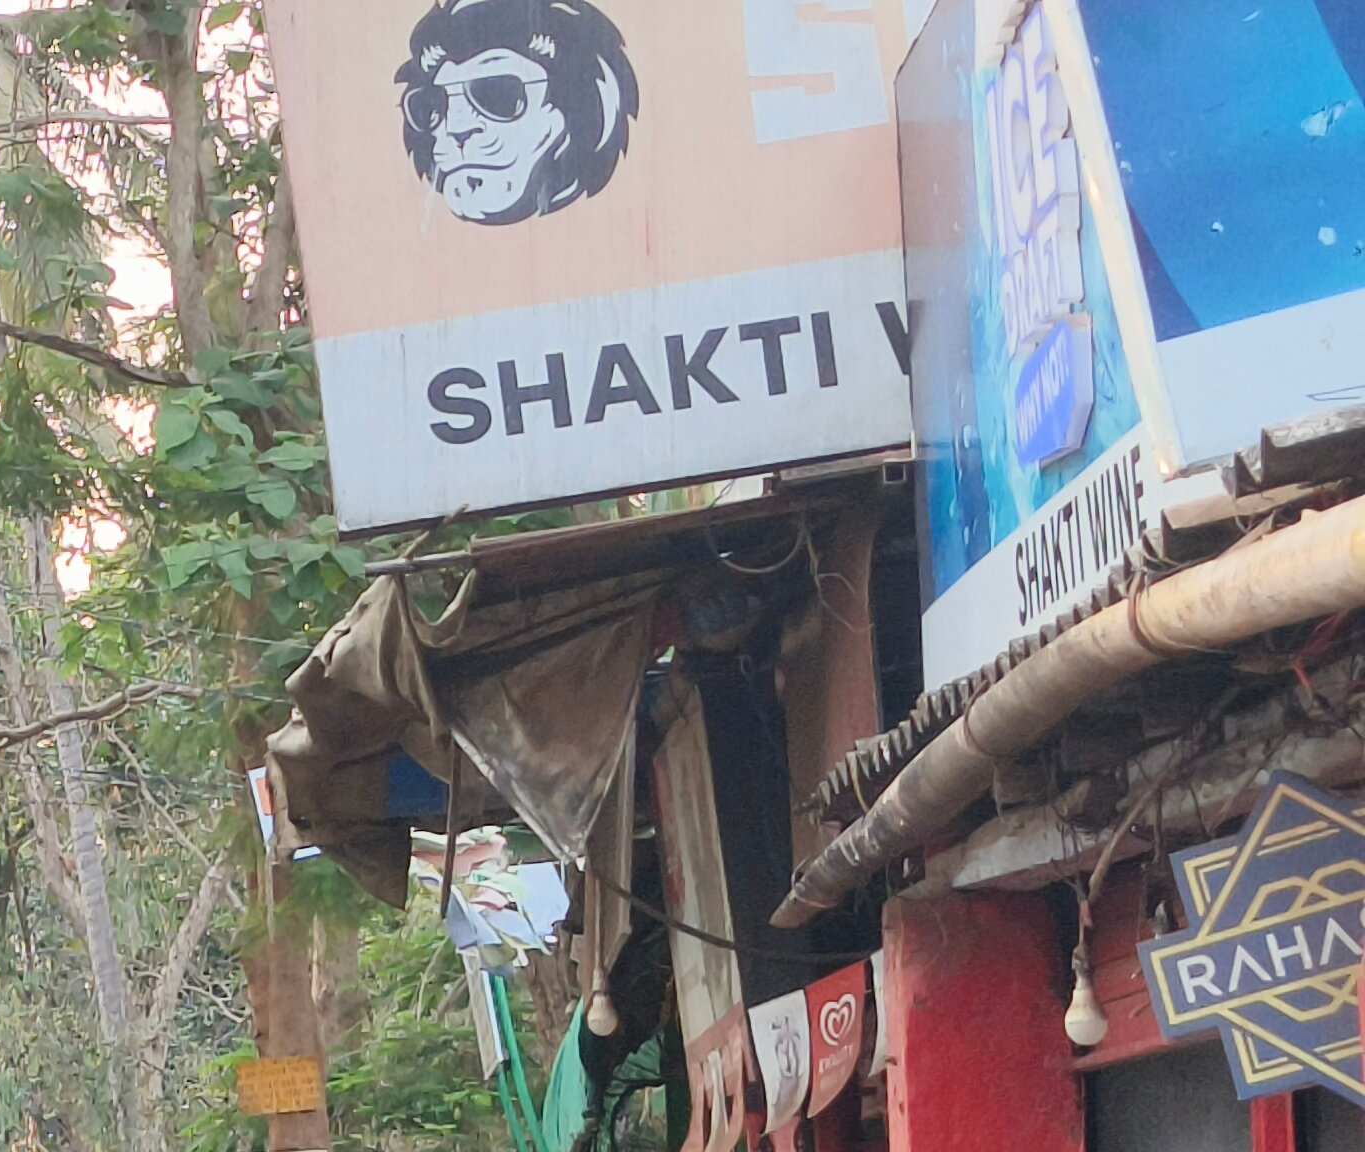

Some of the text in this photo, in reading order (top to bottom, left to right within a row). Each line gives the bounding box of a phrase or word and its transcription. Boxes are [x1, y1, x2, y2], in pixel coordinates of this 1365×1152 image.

[983, 8, 1059, 258] ICE
[427, 311, 839, 444] SHAKTI
[1015, 444, 1147, 626] SHAKTI WINE
[1176, 905, 1365, 1004] RAHA
